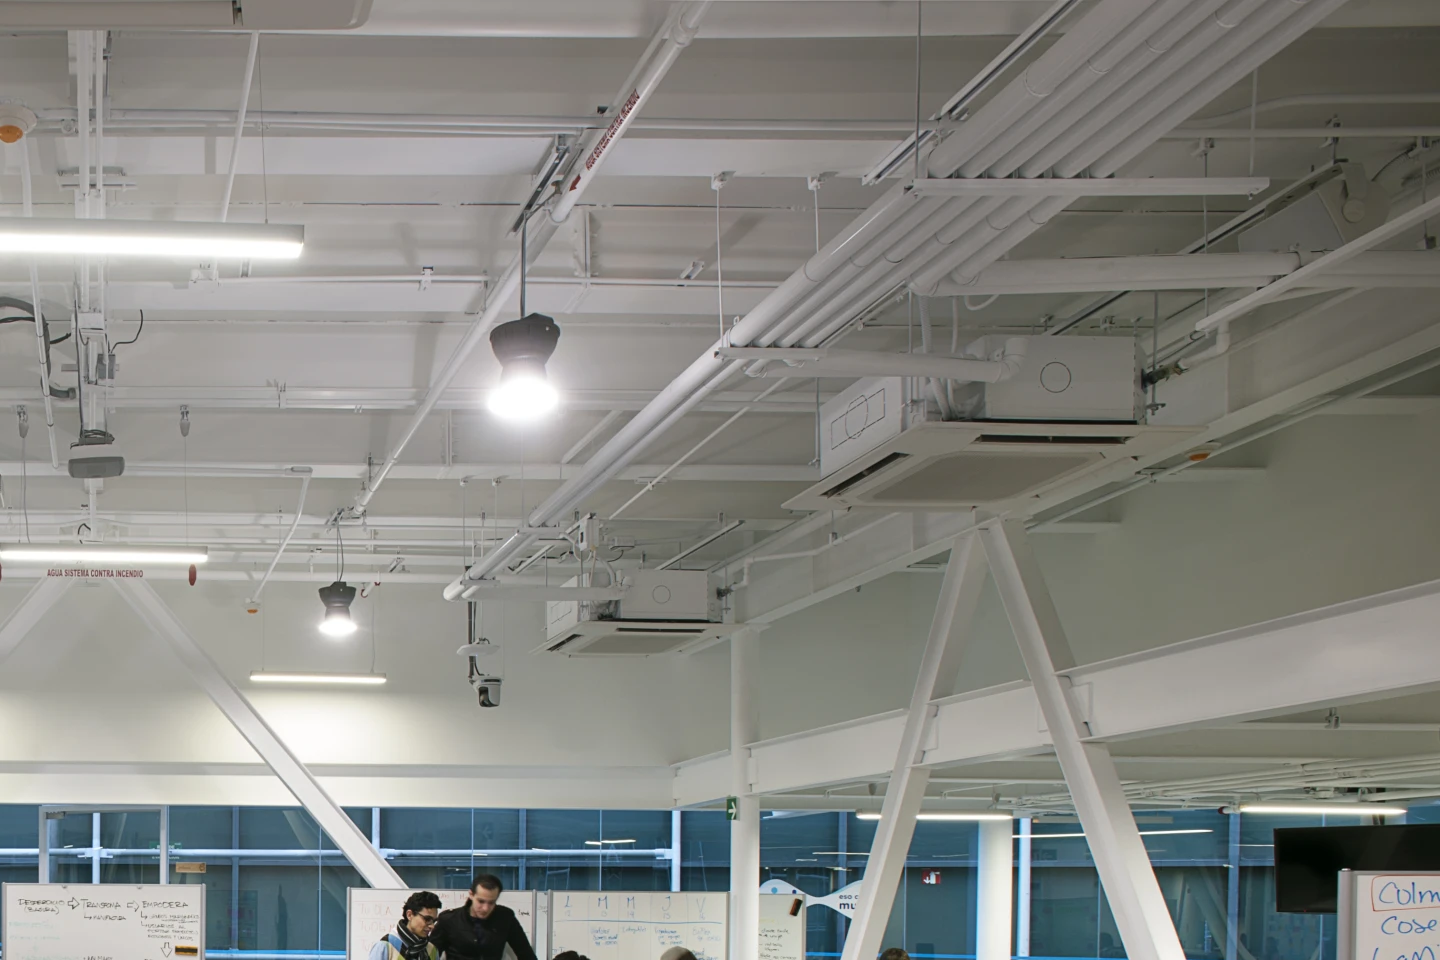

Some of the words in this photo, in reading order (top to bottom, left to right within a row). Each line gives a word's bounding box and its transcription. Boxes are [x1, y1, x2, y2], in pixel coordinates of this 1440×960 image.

[47, 569, 63, 577] AGUA
[64, 569, 89, 577] SISTEMA
[90, 569, 115, 578] CONTRA
[115, 569, 144, 578] INCENDIO
[141, 900, 189, 909] EMPODERA
[597, 895, 608, 910] M
[626, 895, 635, 910] M
